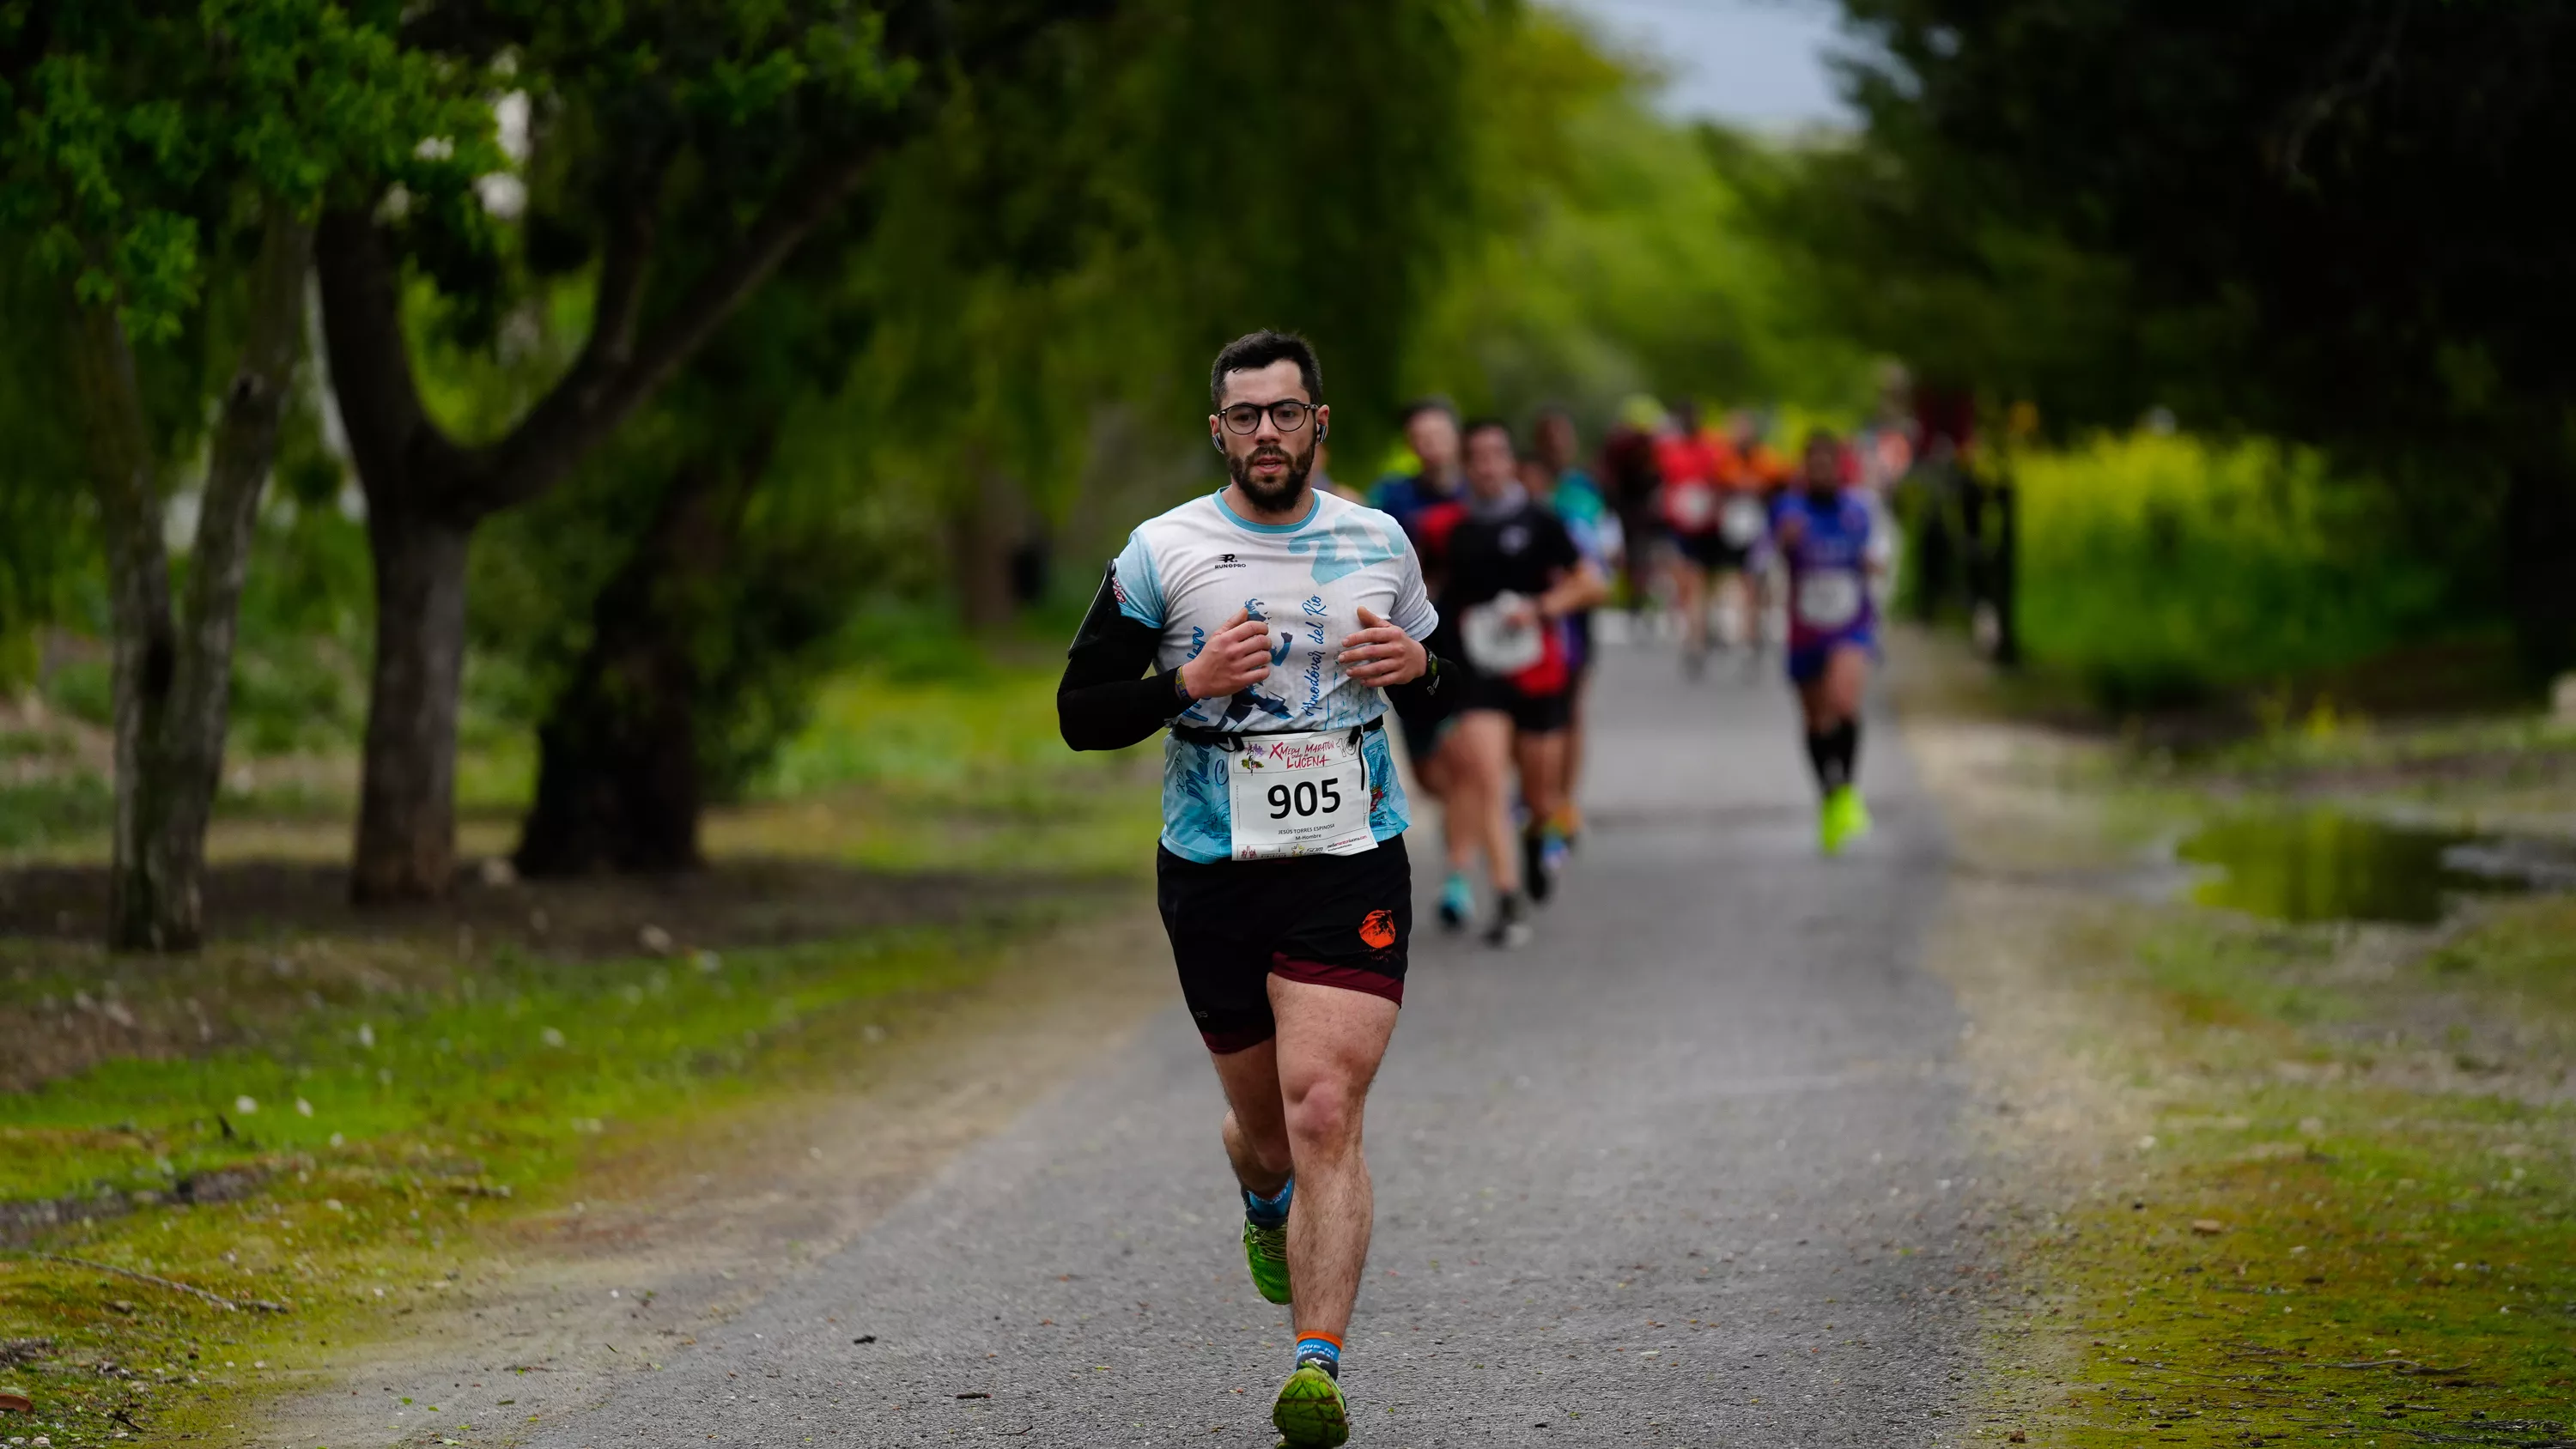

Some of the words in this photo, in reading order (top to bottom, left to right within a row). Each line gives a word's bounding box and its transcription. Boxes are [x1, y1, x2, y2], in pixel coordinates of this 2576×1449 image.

[1302, 594, 1328, 616] Río
[1305, 621, 1324, 645] del
[1301, 650, 1326, 717] Almodóvar
[1269, 742, 1284, 761] X
[1286, 755, 1331, 769] LUCENA
[1267, 778, 1341, 820] 905
[1294, 826, 1313, 834] TORRES
[1313, 823, 1335, 832] ESPINOSA
